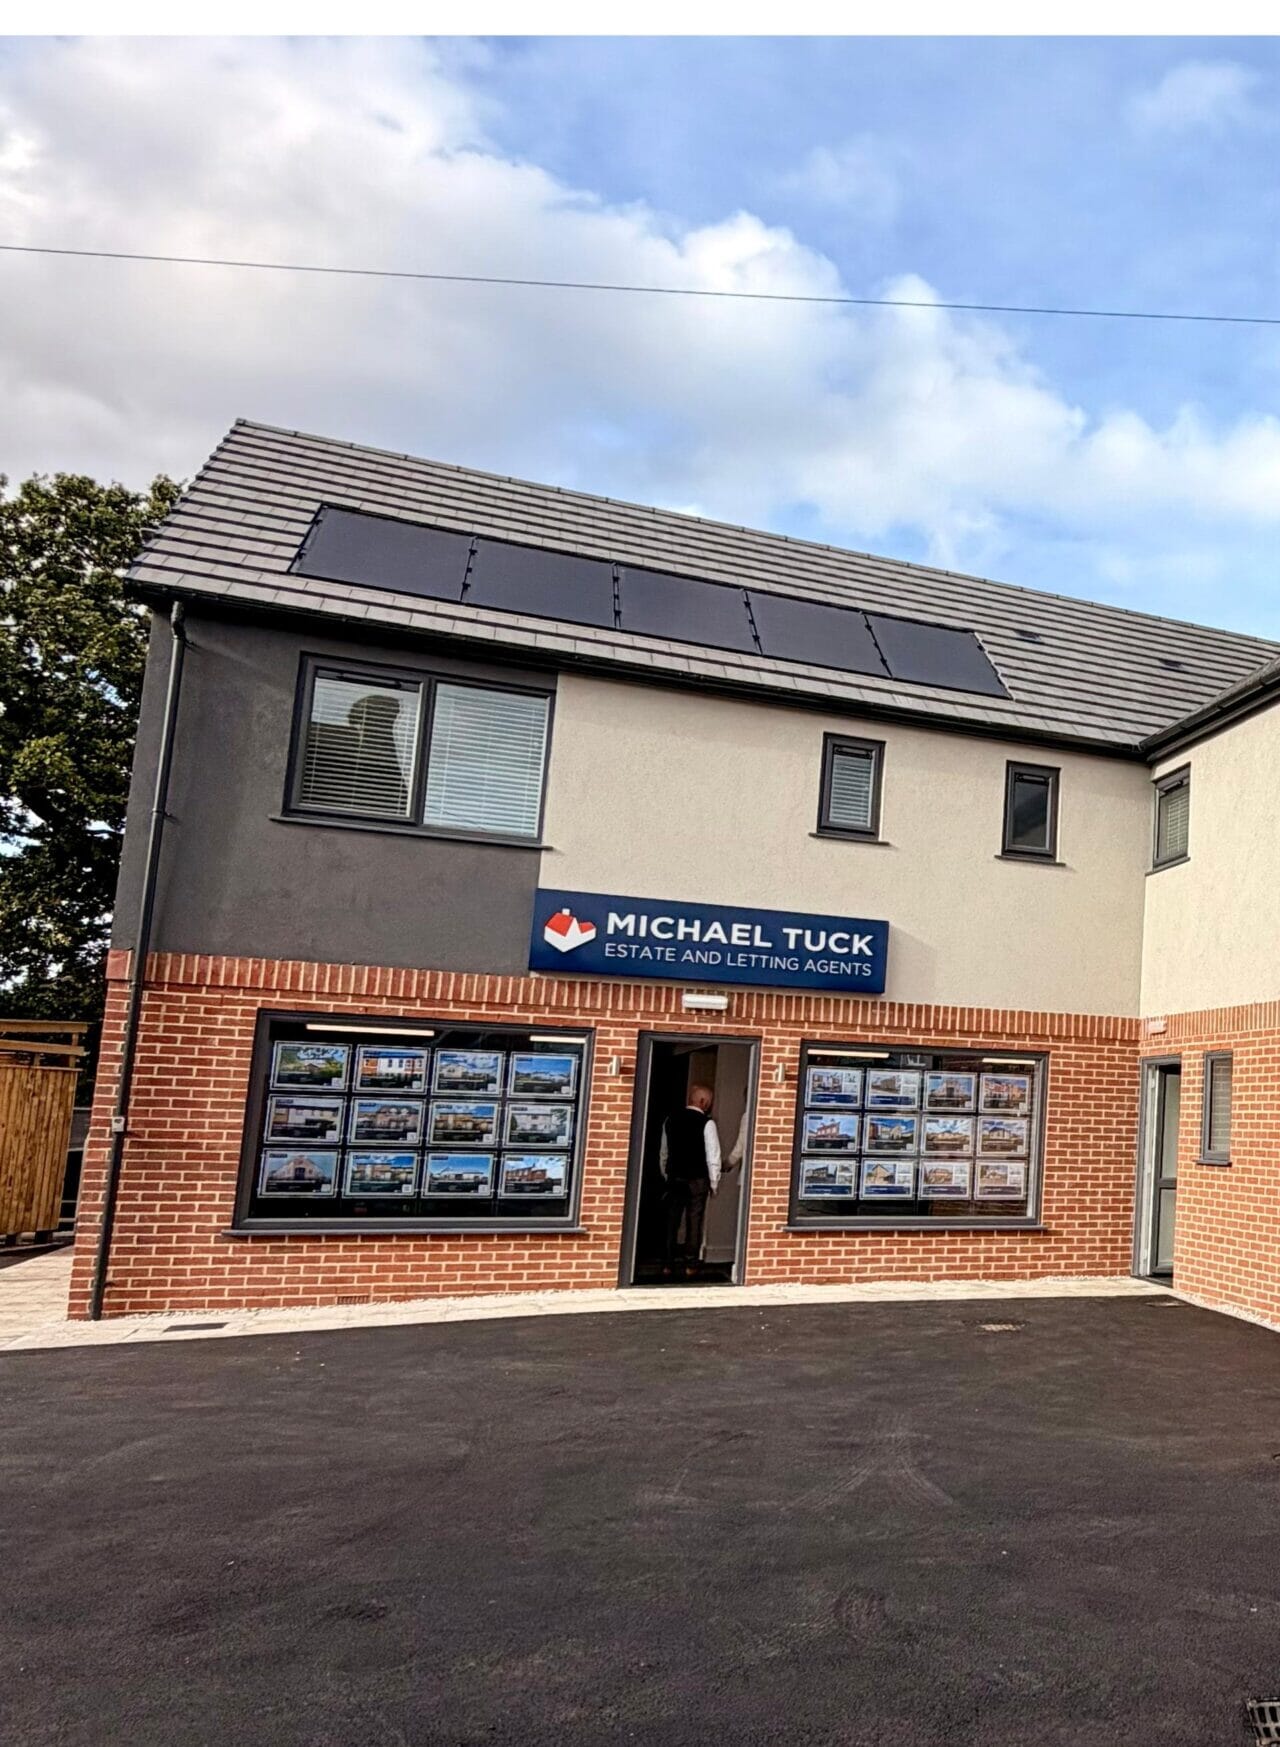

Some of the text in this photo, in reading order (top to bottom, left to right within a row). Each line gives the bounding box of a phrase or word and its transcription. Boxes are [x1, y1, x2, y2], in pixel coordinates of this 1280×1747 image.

[606, 912, 874, 957] MICHAEL TUCK
[604, 942, 872, 977] ESTATE AND LETTING AGENTS
